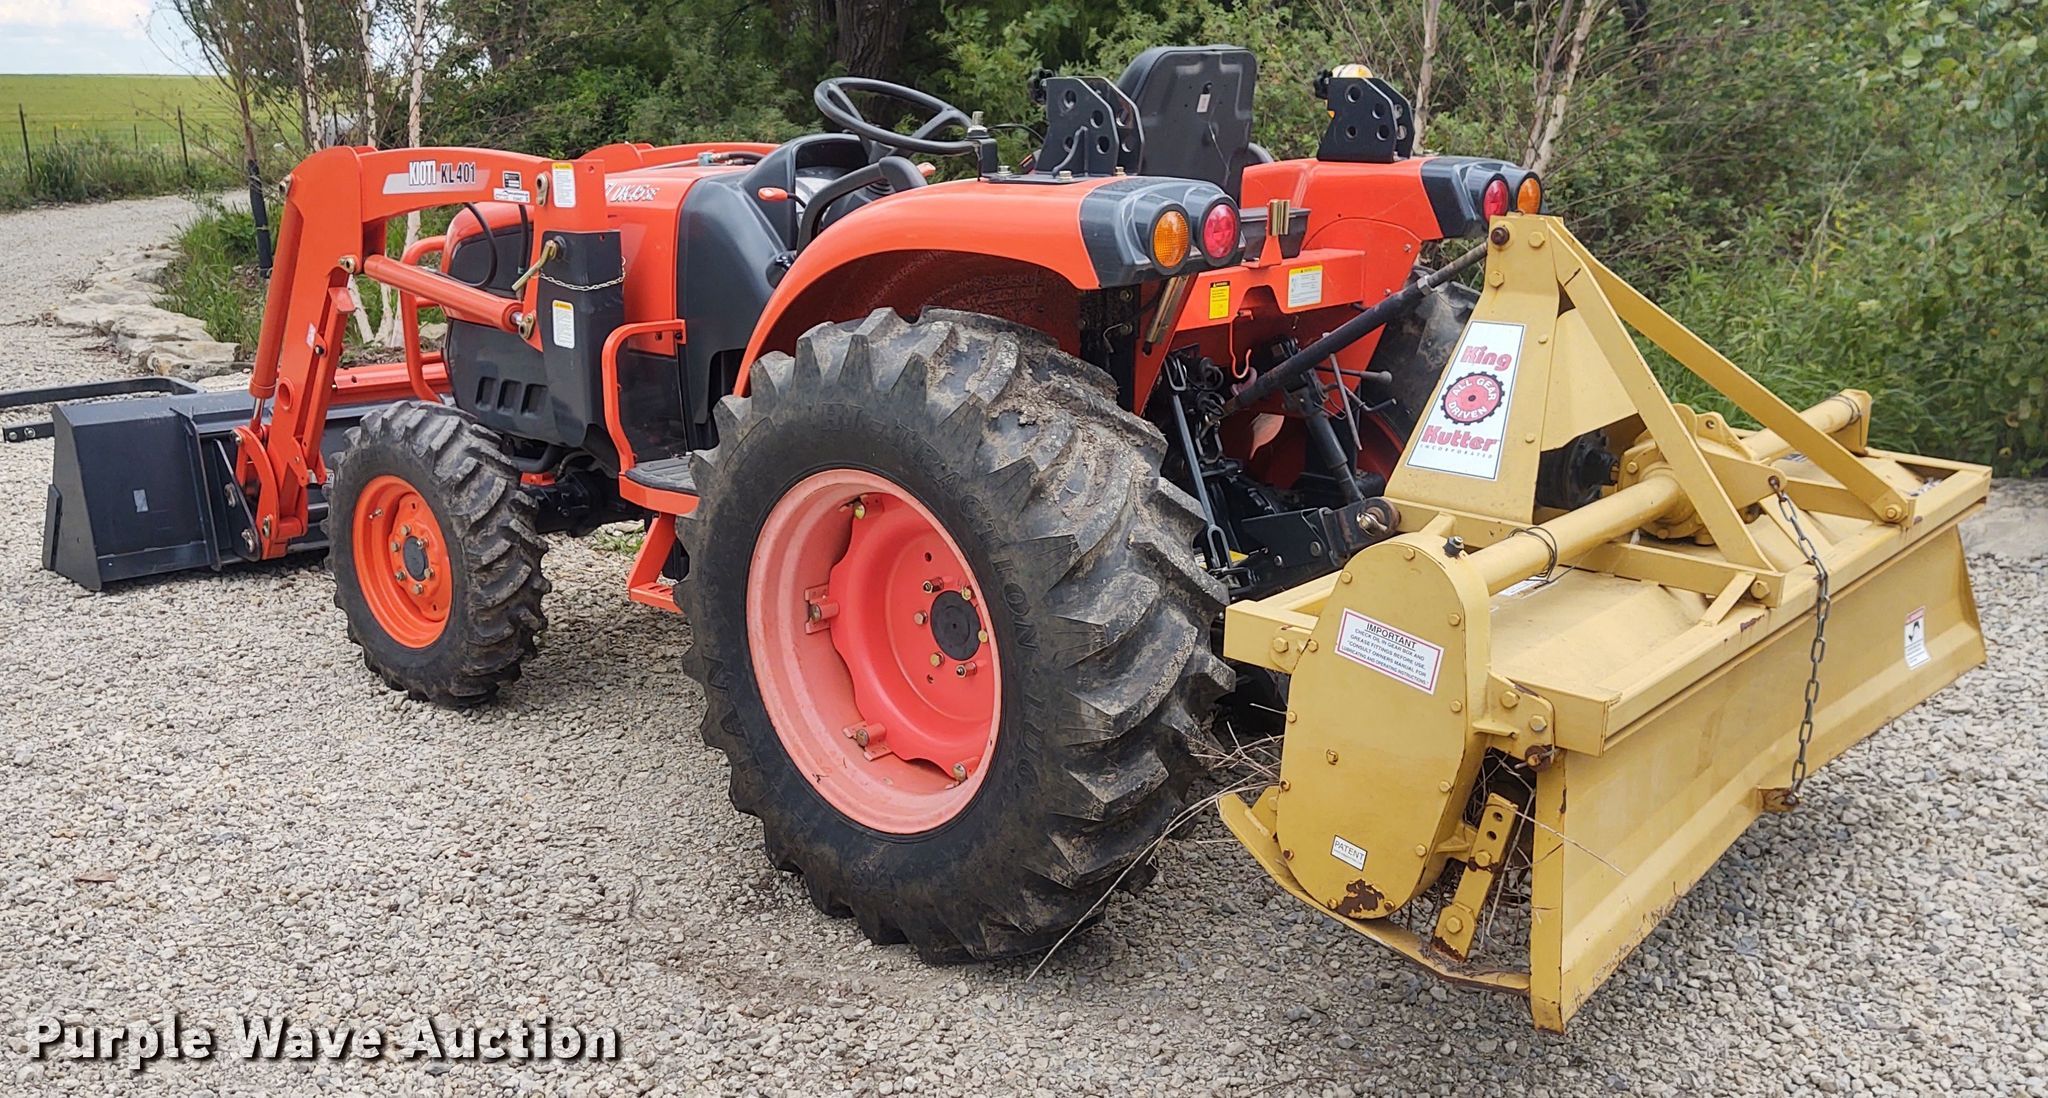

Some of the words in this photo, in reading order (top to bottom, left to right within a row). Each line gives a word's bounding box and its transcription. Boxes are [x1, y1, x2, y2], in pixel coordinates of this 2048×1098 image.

[409, 160, 436, 186] KIOTI
[441, 164, 454, 184] KL
[456, 162, 476, 184] 401
[1460, 345, 1512, 372] King
[1452, 378, 1473, 397] ALL
[1476, 377, 1497, 401] GEAR
[1448, 401, 1488, 420] DRIVEN
[1421, 424, 1498, 452] Kutter
[1420, 444, 1494, 460] INCORPORATED
[1355, 628, 1372, 639] CHECK
[1388, 641, 1402, 652] GEAR
[1402, 648, 1413, 657] BOX
[1414, 653, 1424, 661] AND
[1366, 623, 1417, 648] IMPORTANT
[1350, 634, 1370, 646] GREASE
[1371, 642, 1392, 655] FITTINGS
[1393, 653, 1414, 664] BEFORE
[1394, 660, 1414, 672] MANUAL
[1415, 669, 1426, 677] FOR
[1334, 840, 1364, 860] PATENT
